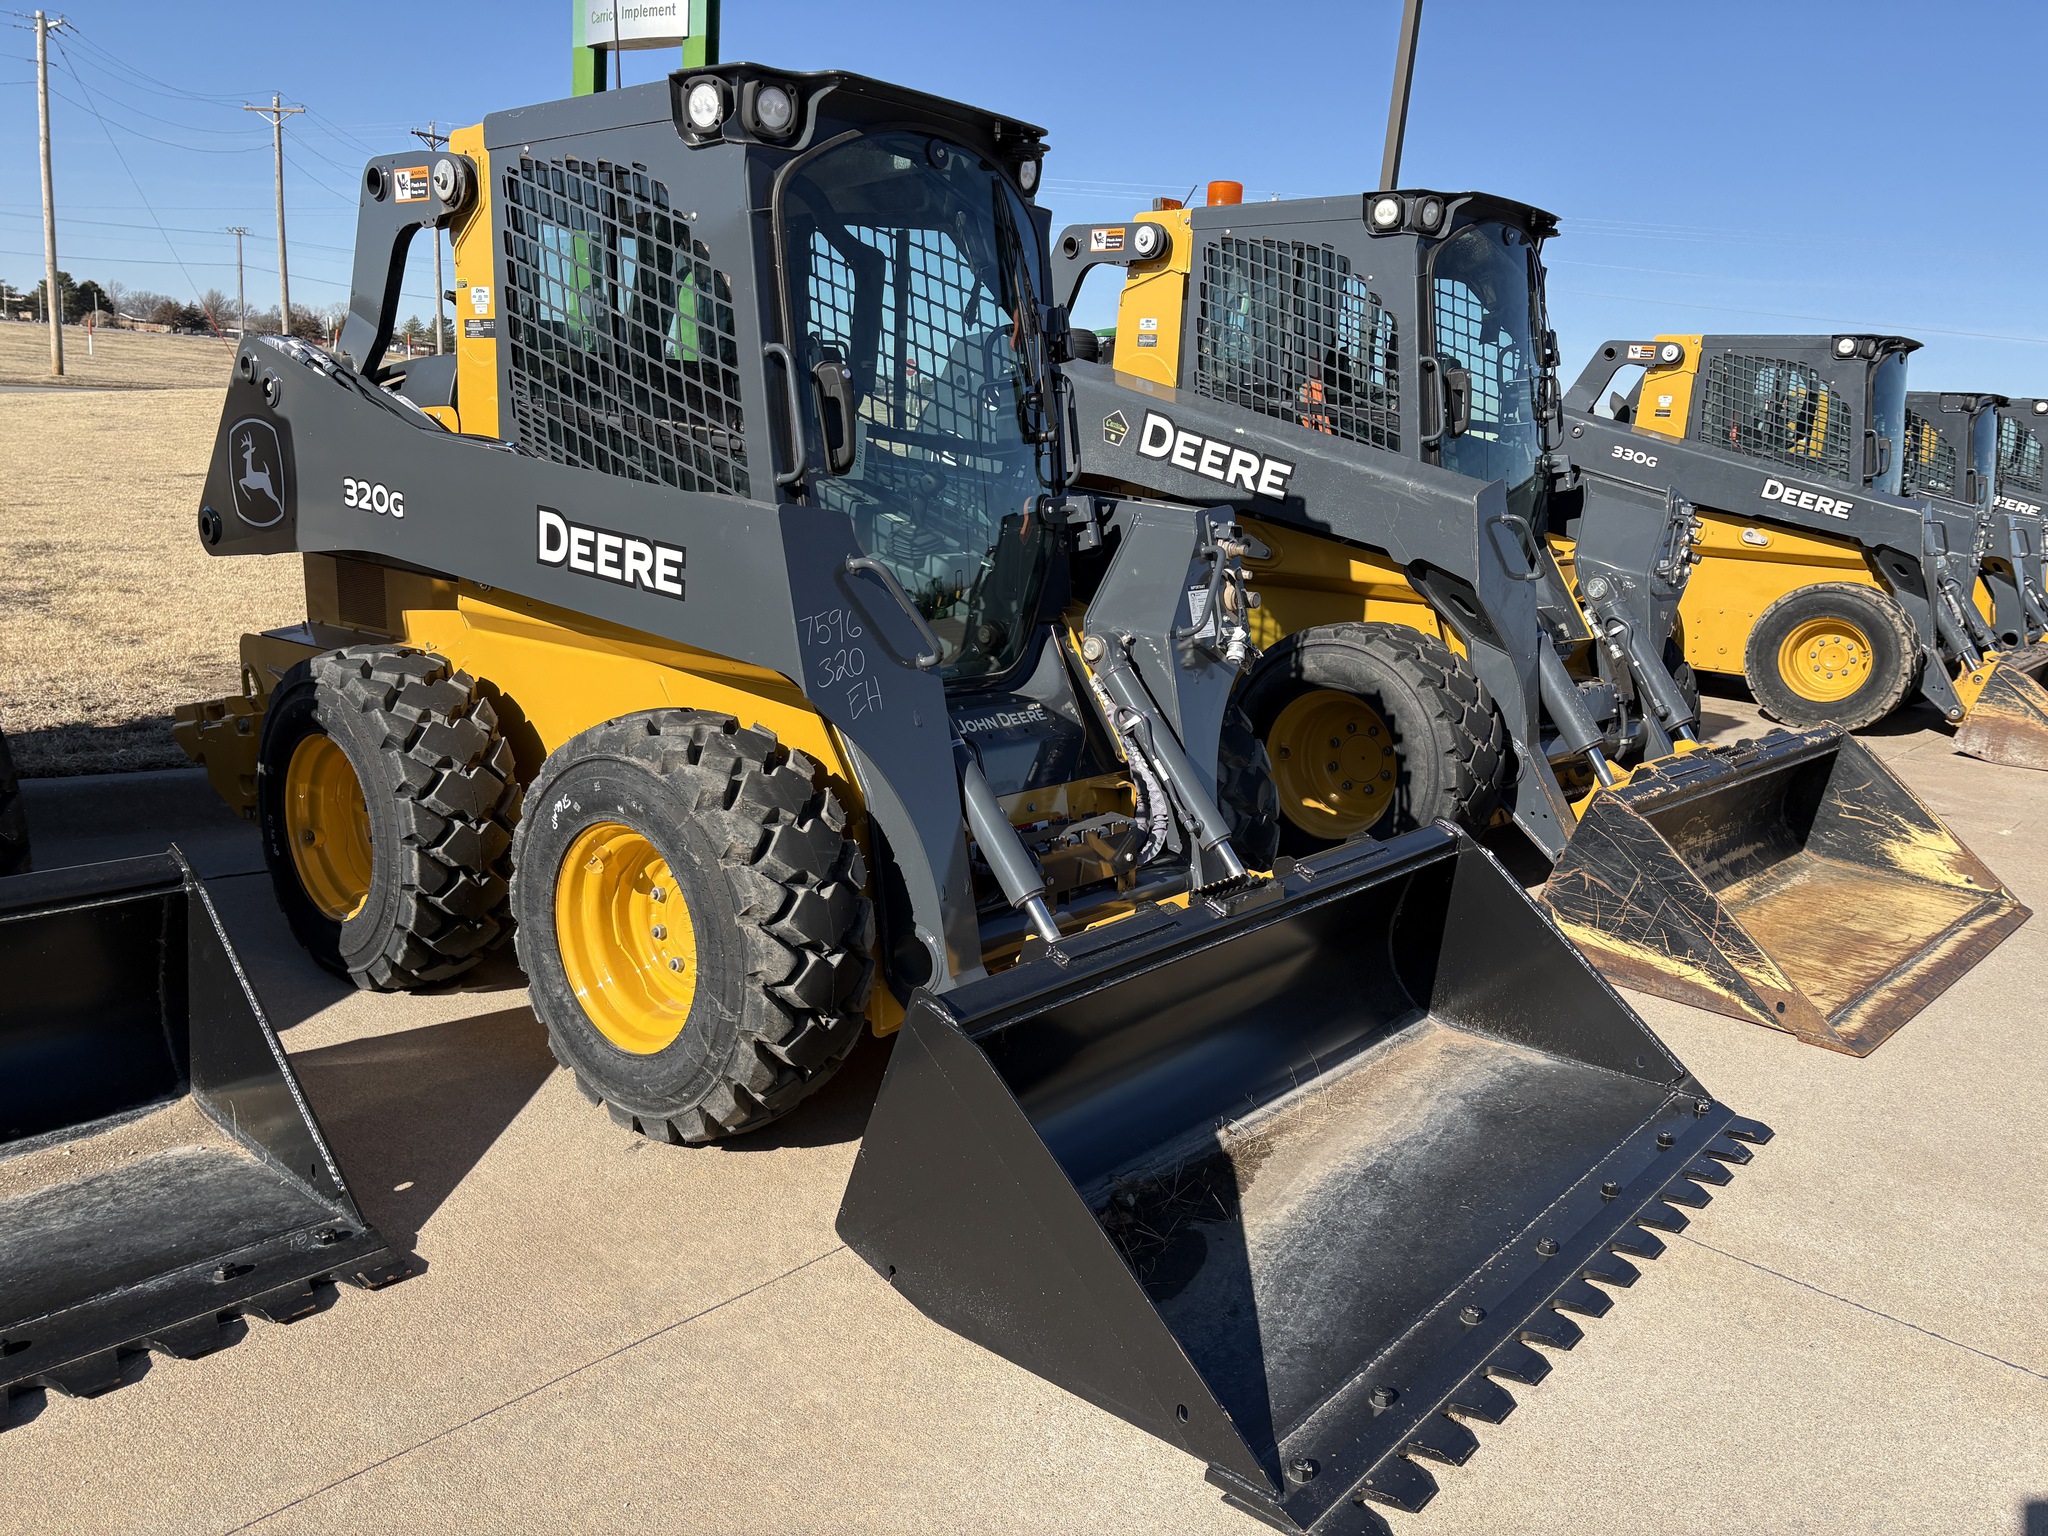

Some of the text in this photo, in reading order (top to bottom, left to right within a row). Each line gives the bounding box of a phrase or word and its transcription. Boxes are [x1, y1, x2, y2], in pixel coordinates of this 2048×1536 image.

[591, 3, 677, 24] Carric Implement
[1139, 412, 1293, 500] DEERE
[1611, 445, 1658, 468] 330G
[343, 477, 404, 518] 320G
[1760, 478, 1854, 520] DEERE
[1993, 495, 2041, 516] EERE
[538, 510, 683, 596] DEERE
[798, 608, 863, 646] 7596
[817, 647, 865, 689] 320
[846, 675, 884, 721] EH
[958, 708, 1048, 735] JOHN DEERE
